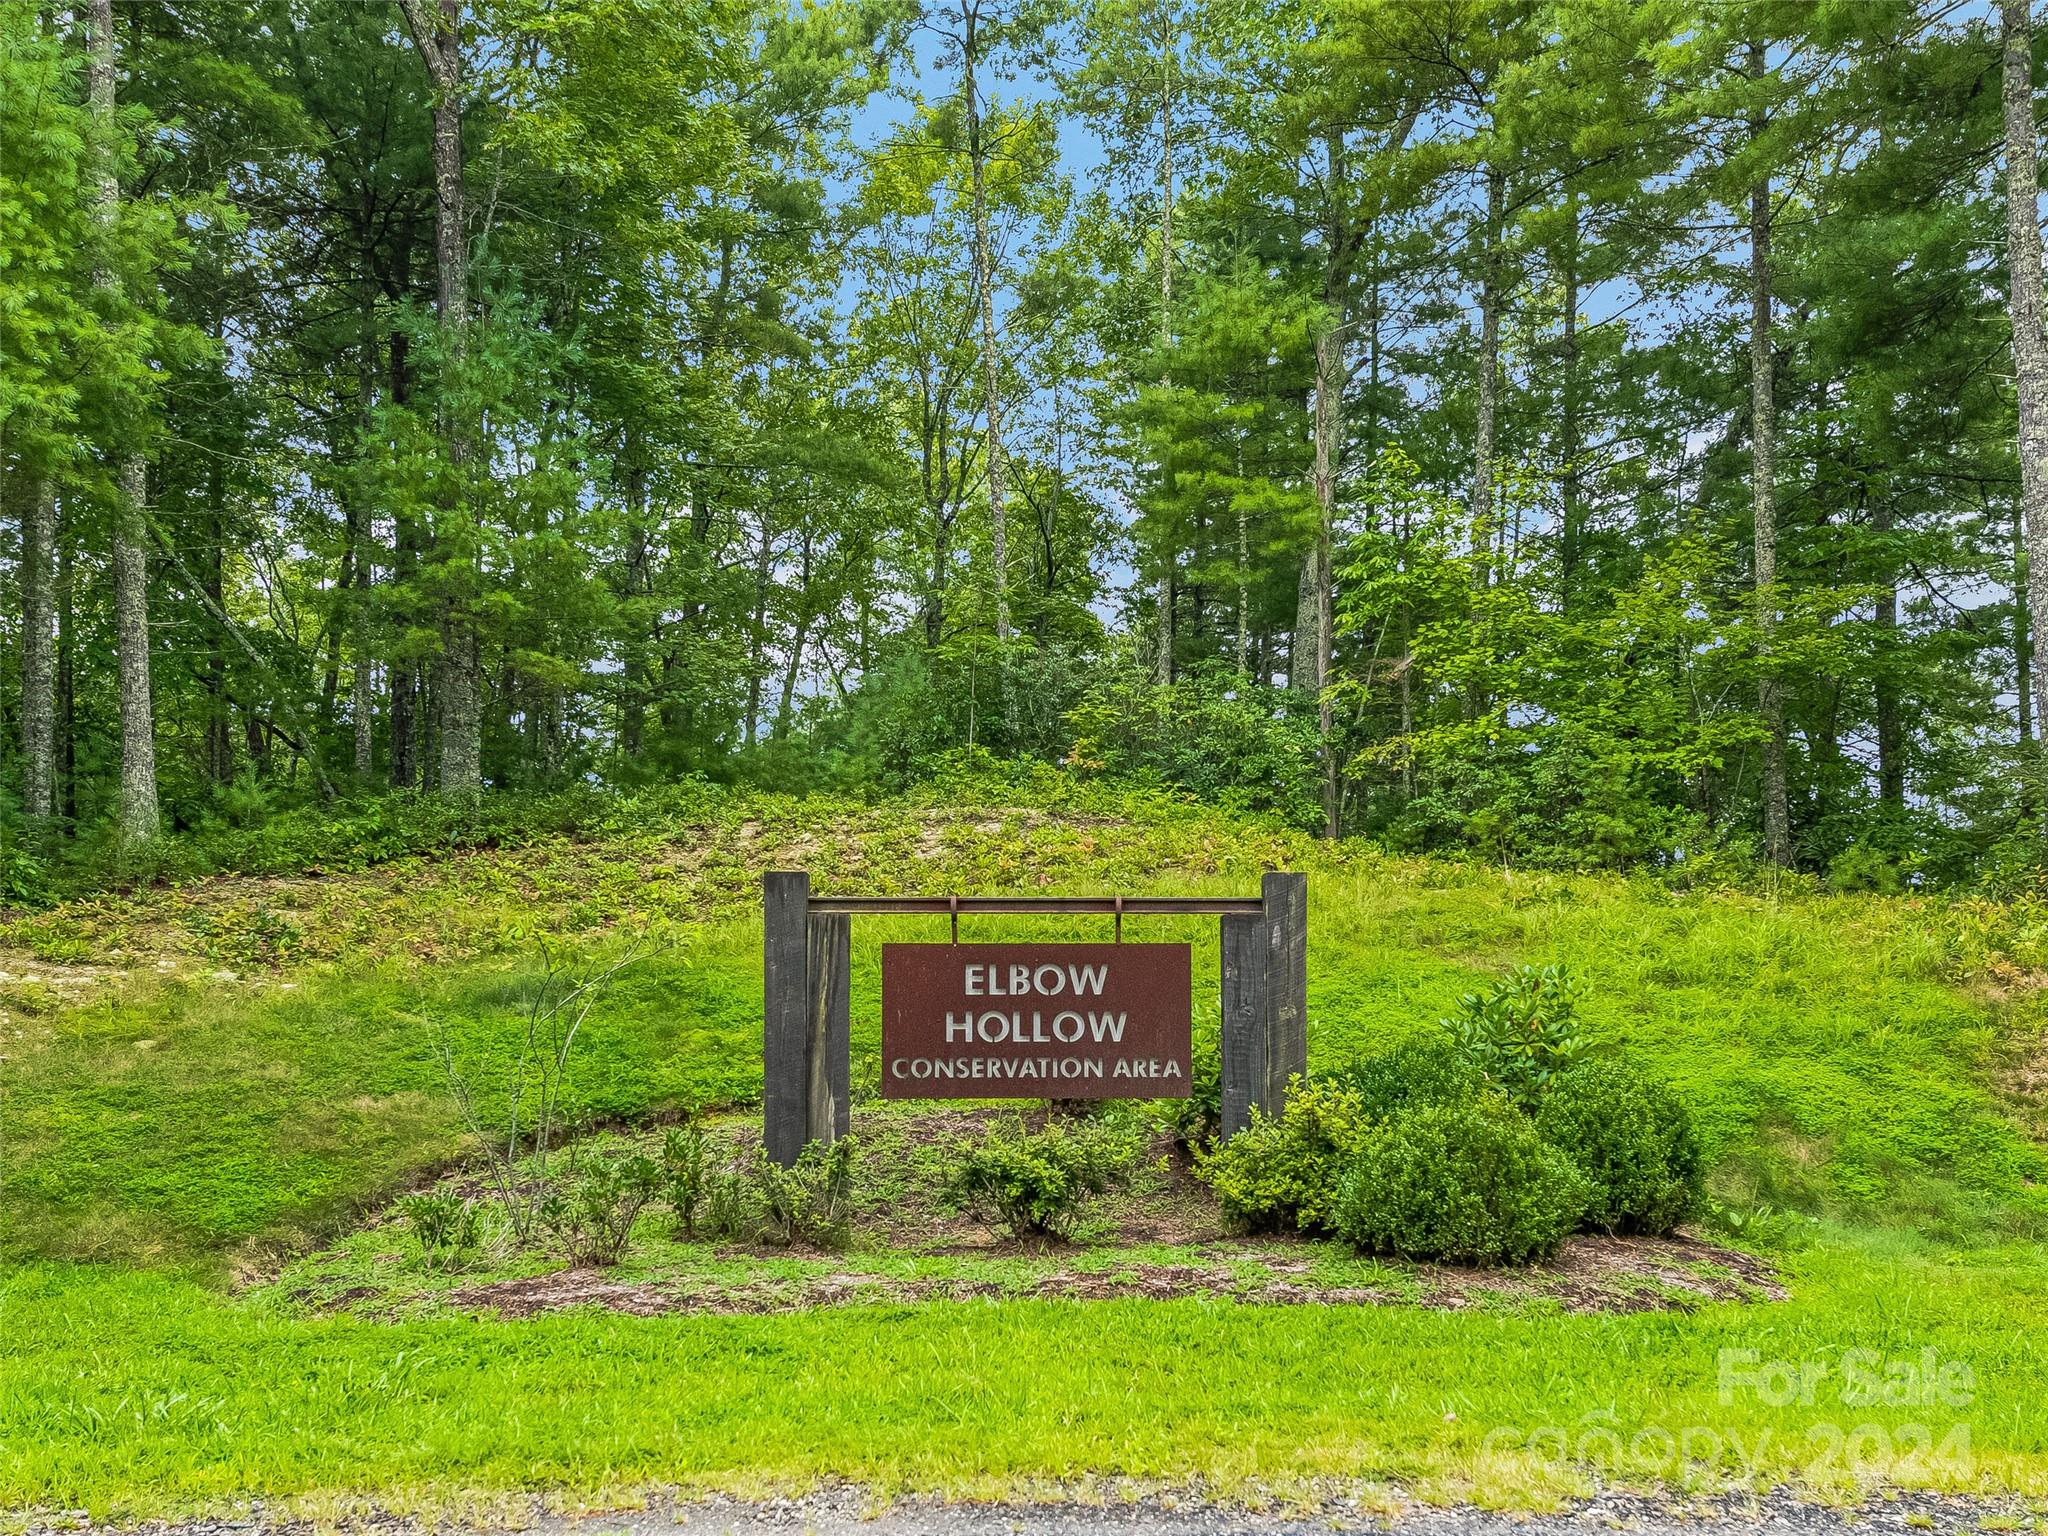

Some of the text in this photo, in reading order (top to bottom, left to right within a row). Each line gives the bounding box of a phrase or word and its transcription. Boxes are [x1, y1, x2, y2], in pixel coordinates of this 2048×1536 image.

[964, 963, 1109, 996] ELBOW
[945, 1010, 1128, 1043] HOLLOW
[891, 1056, 1183, 1079] CONSERVATION AREA
